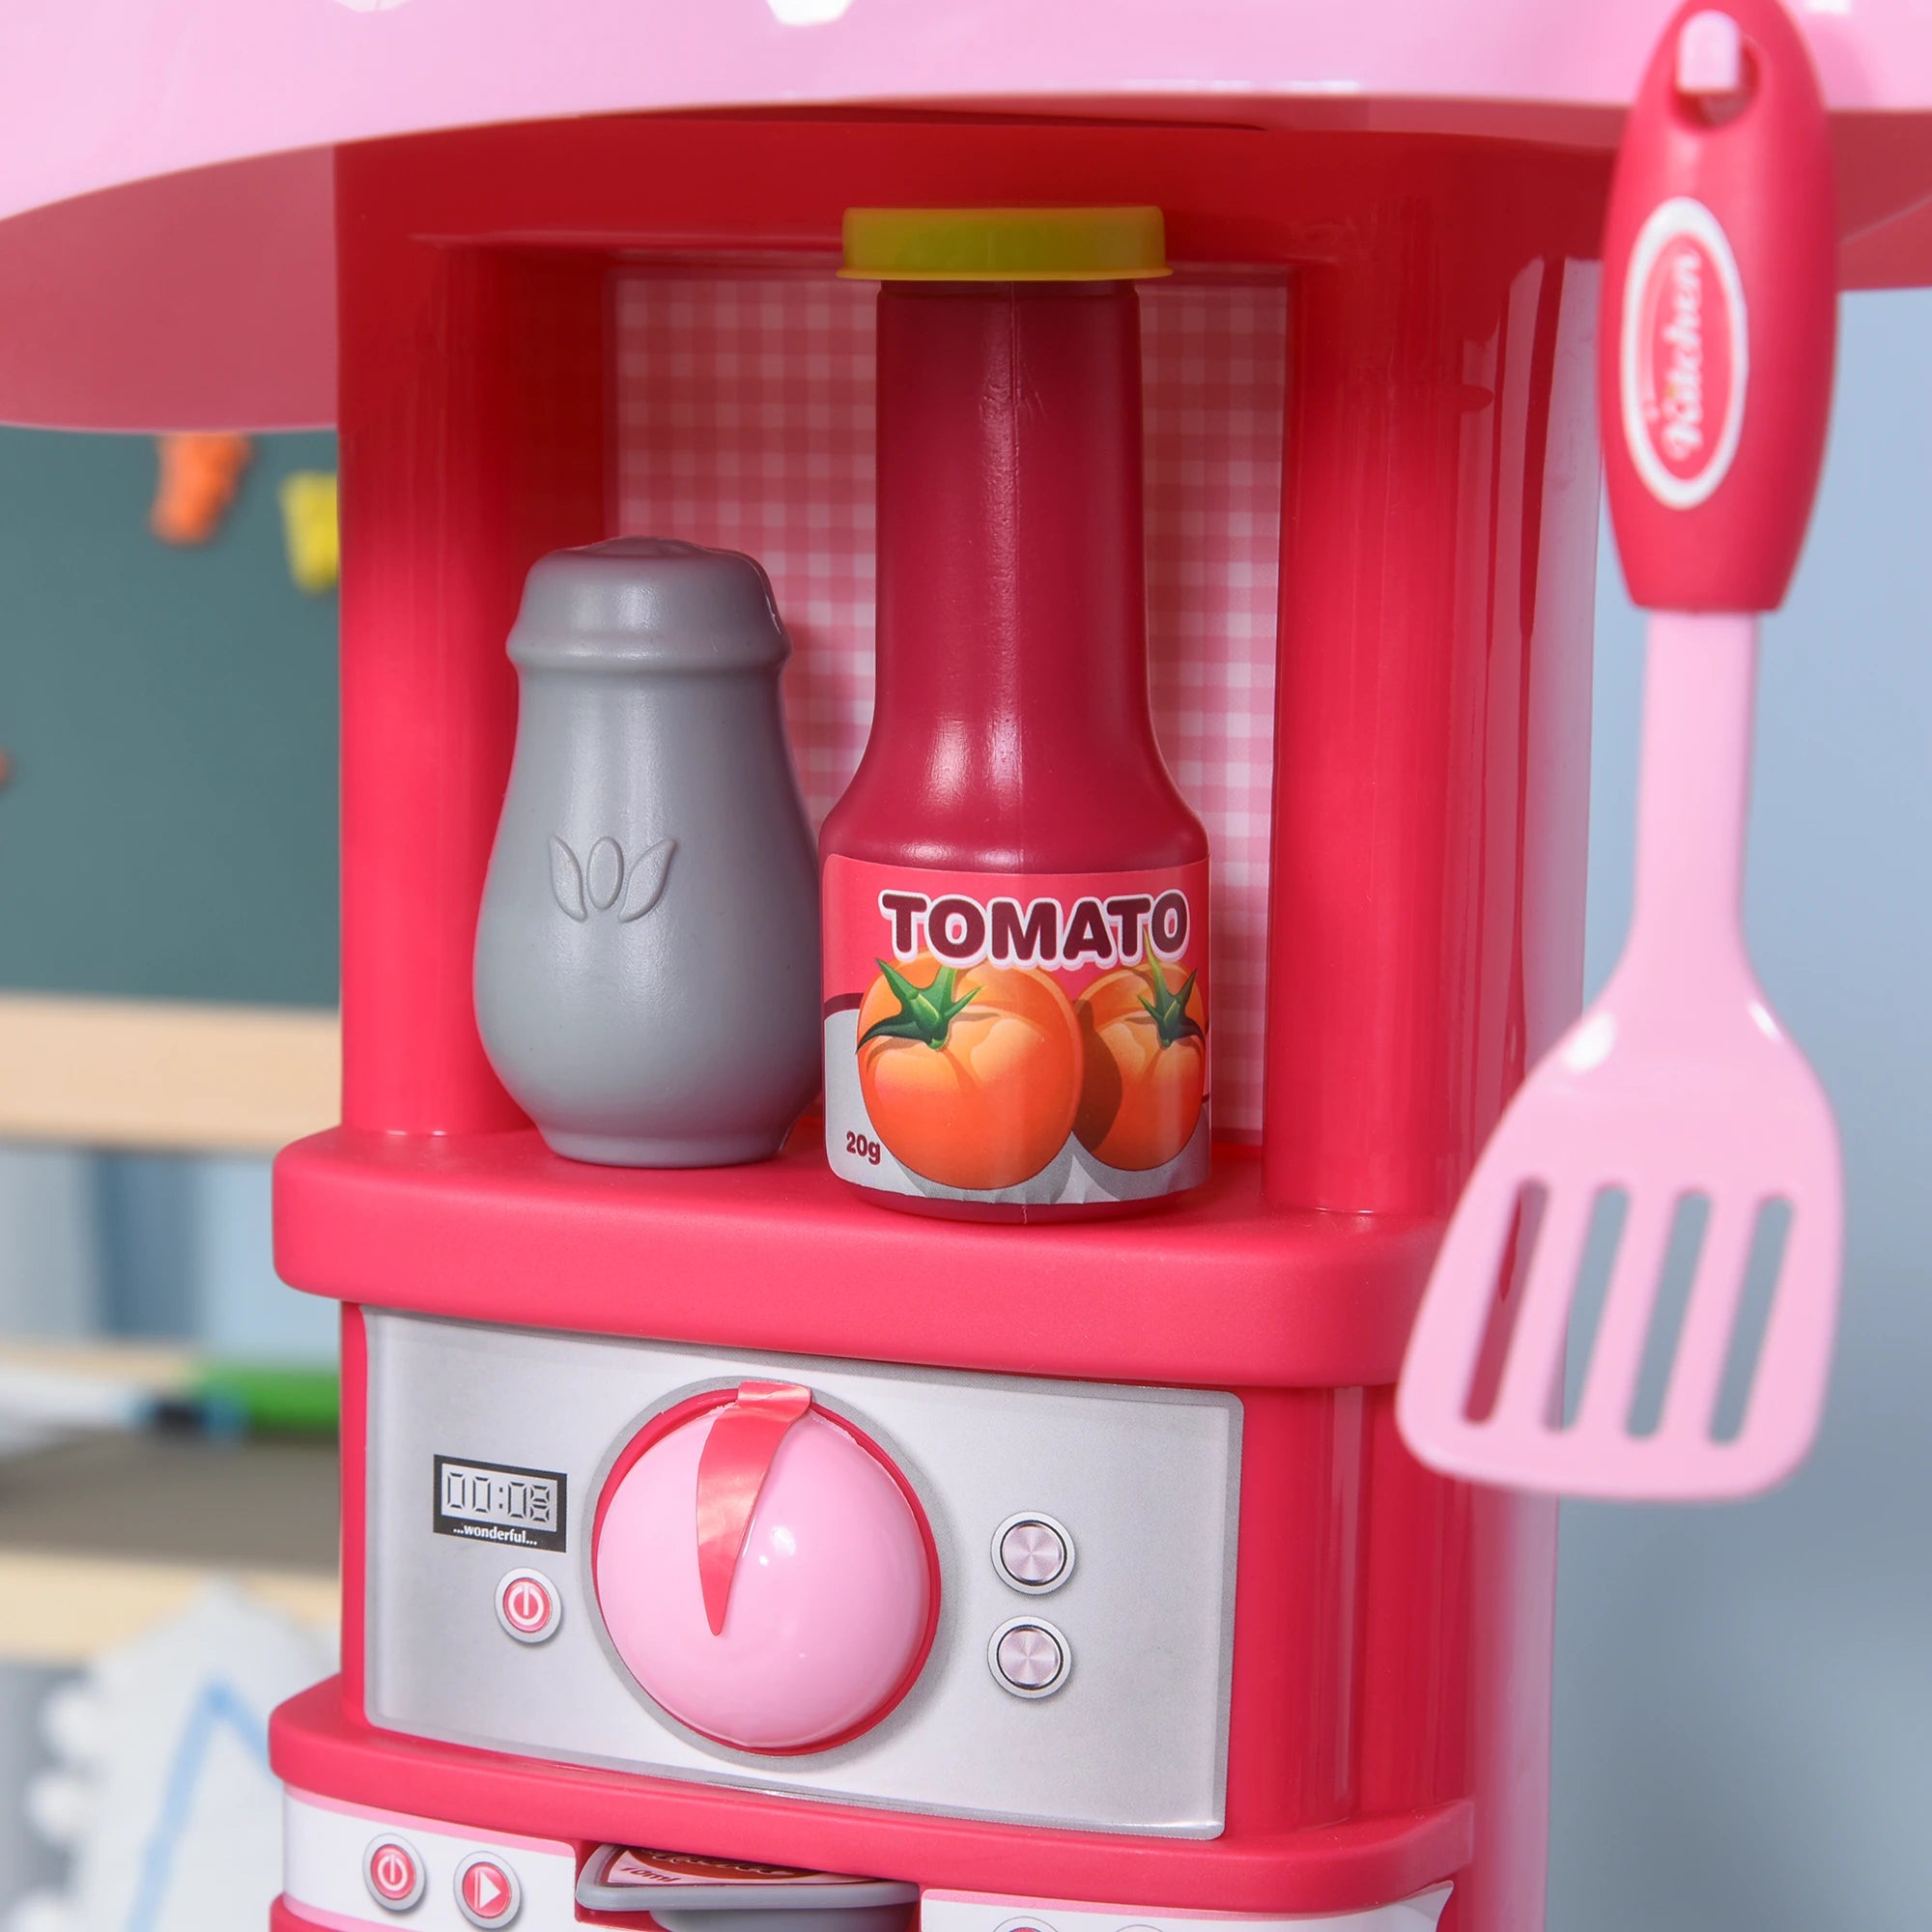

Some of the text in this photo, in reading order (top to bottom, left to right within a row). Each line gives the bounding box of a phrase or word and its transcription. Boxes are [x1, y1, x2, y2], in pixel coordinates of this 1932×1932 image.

[1662, 249, 1703, 461] Kitchen
[878, 890, 1189, 970] TOMATO
[845, 1130, 881, 1165] 20g
